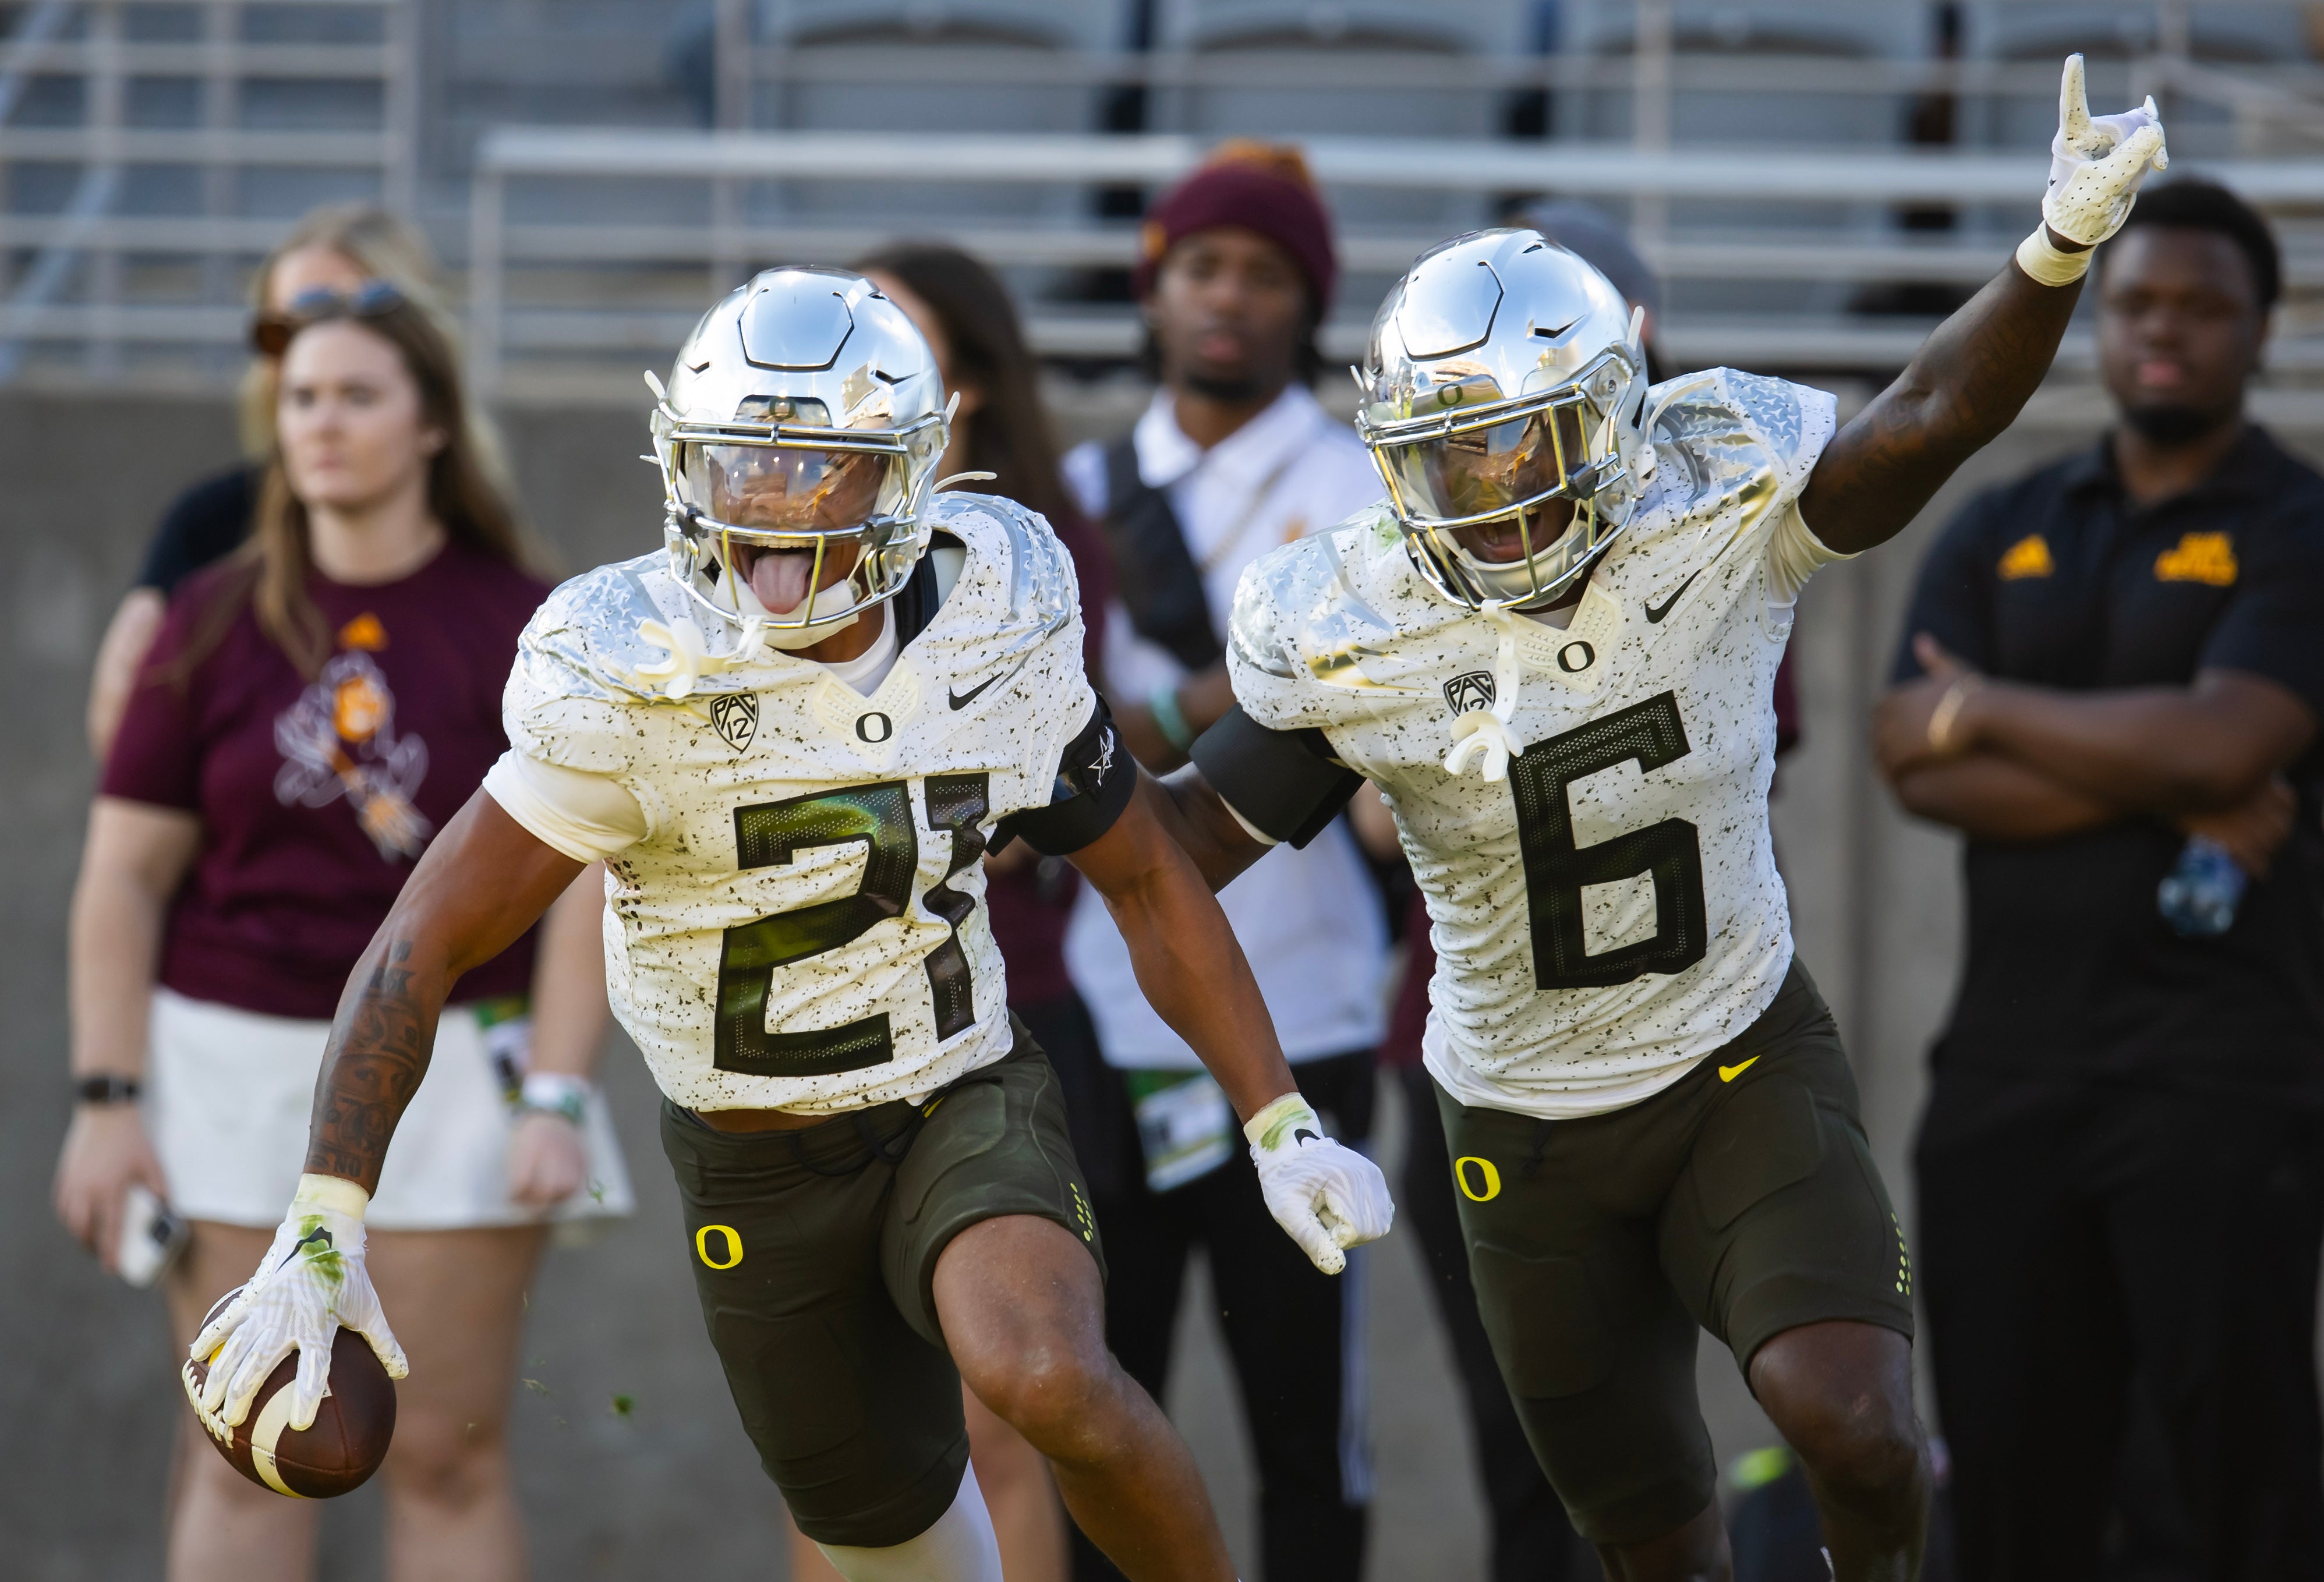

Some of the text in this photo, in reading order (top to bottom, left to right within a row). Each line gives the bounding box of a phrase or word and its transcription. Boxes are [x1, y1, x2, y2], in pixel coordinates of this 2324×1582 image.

[1437, 383, 1463, 406] O
[1557, 640, 1595, 673] O
[714, 694, 756, 730] PAC
[1446, 674, 1492, 713] PAC
[727, 718, 751, 741] 12
[855, 712, 892, 743] O
[1508, 689, 1707, 990] 6
[714, 772, 989, 1078] 21
[1455, 1156, 1501, 1202] O
[696, 1224, 744, 1269] O
